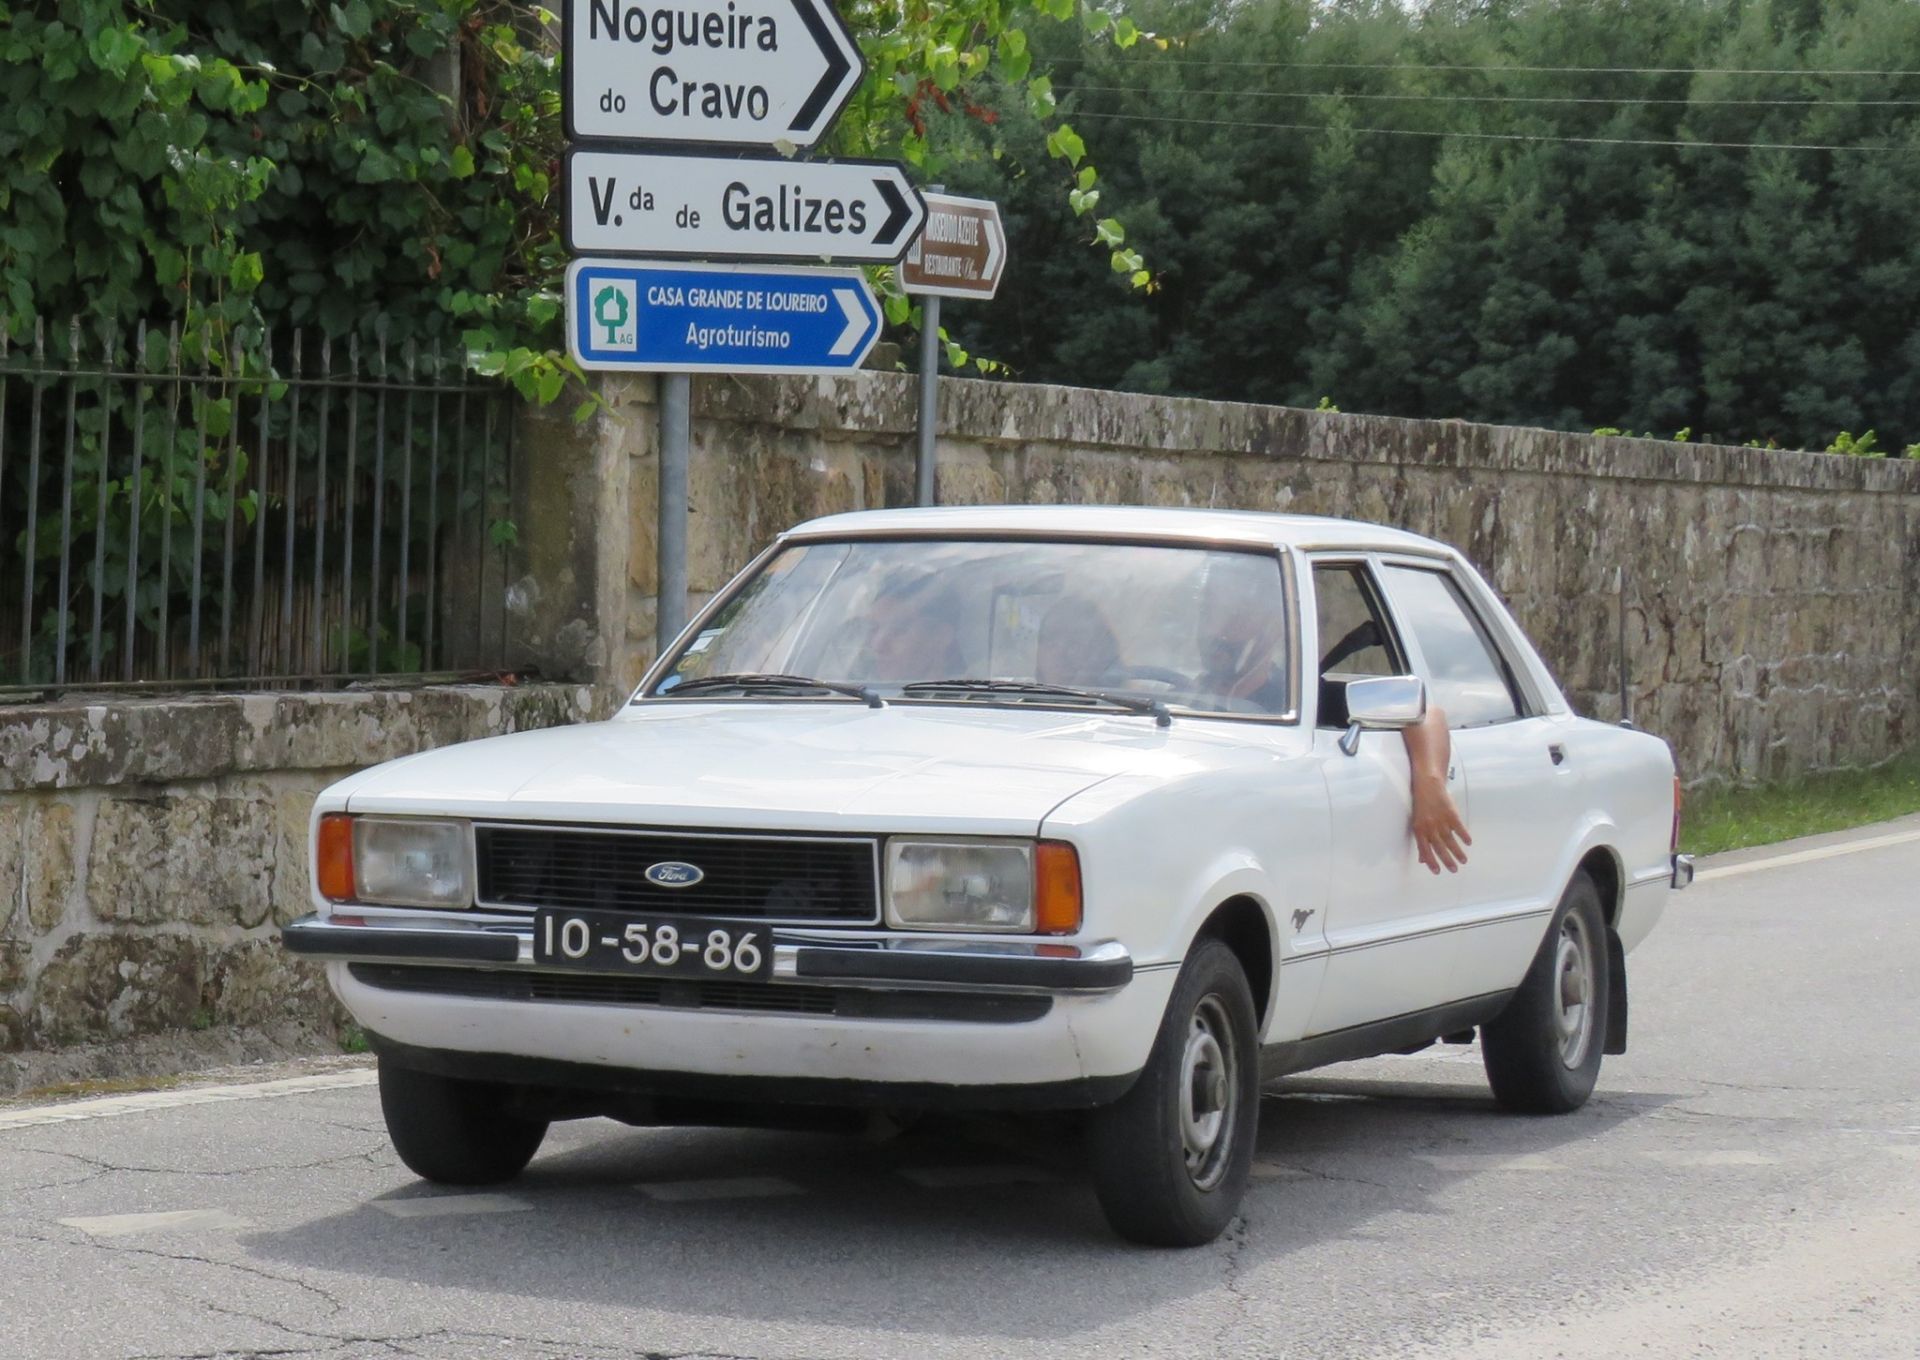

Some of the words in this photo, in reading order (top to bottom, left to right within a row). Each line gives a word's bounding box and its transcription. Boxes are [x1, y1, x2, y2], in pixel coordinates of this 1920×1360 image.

[590, 0, 778, 55] Nogueira
[600, 88, 626, 113] do
[650, 66, 769, 121] Cravo
[676, 204, 700, 228] de
[722, 181, 867, 234] Galizes
[648, 286, 685, 305] CASA
[688, 290, 743, 309] GRANDE
[746, 292, 763, 310] DE
[766, 293, 828, 313] LOUREIRO
[619, 333, 633, 345] AG
[686, 321, 790, 349] Agroturismo
[658, 866, 689, 881] Ford
